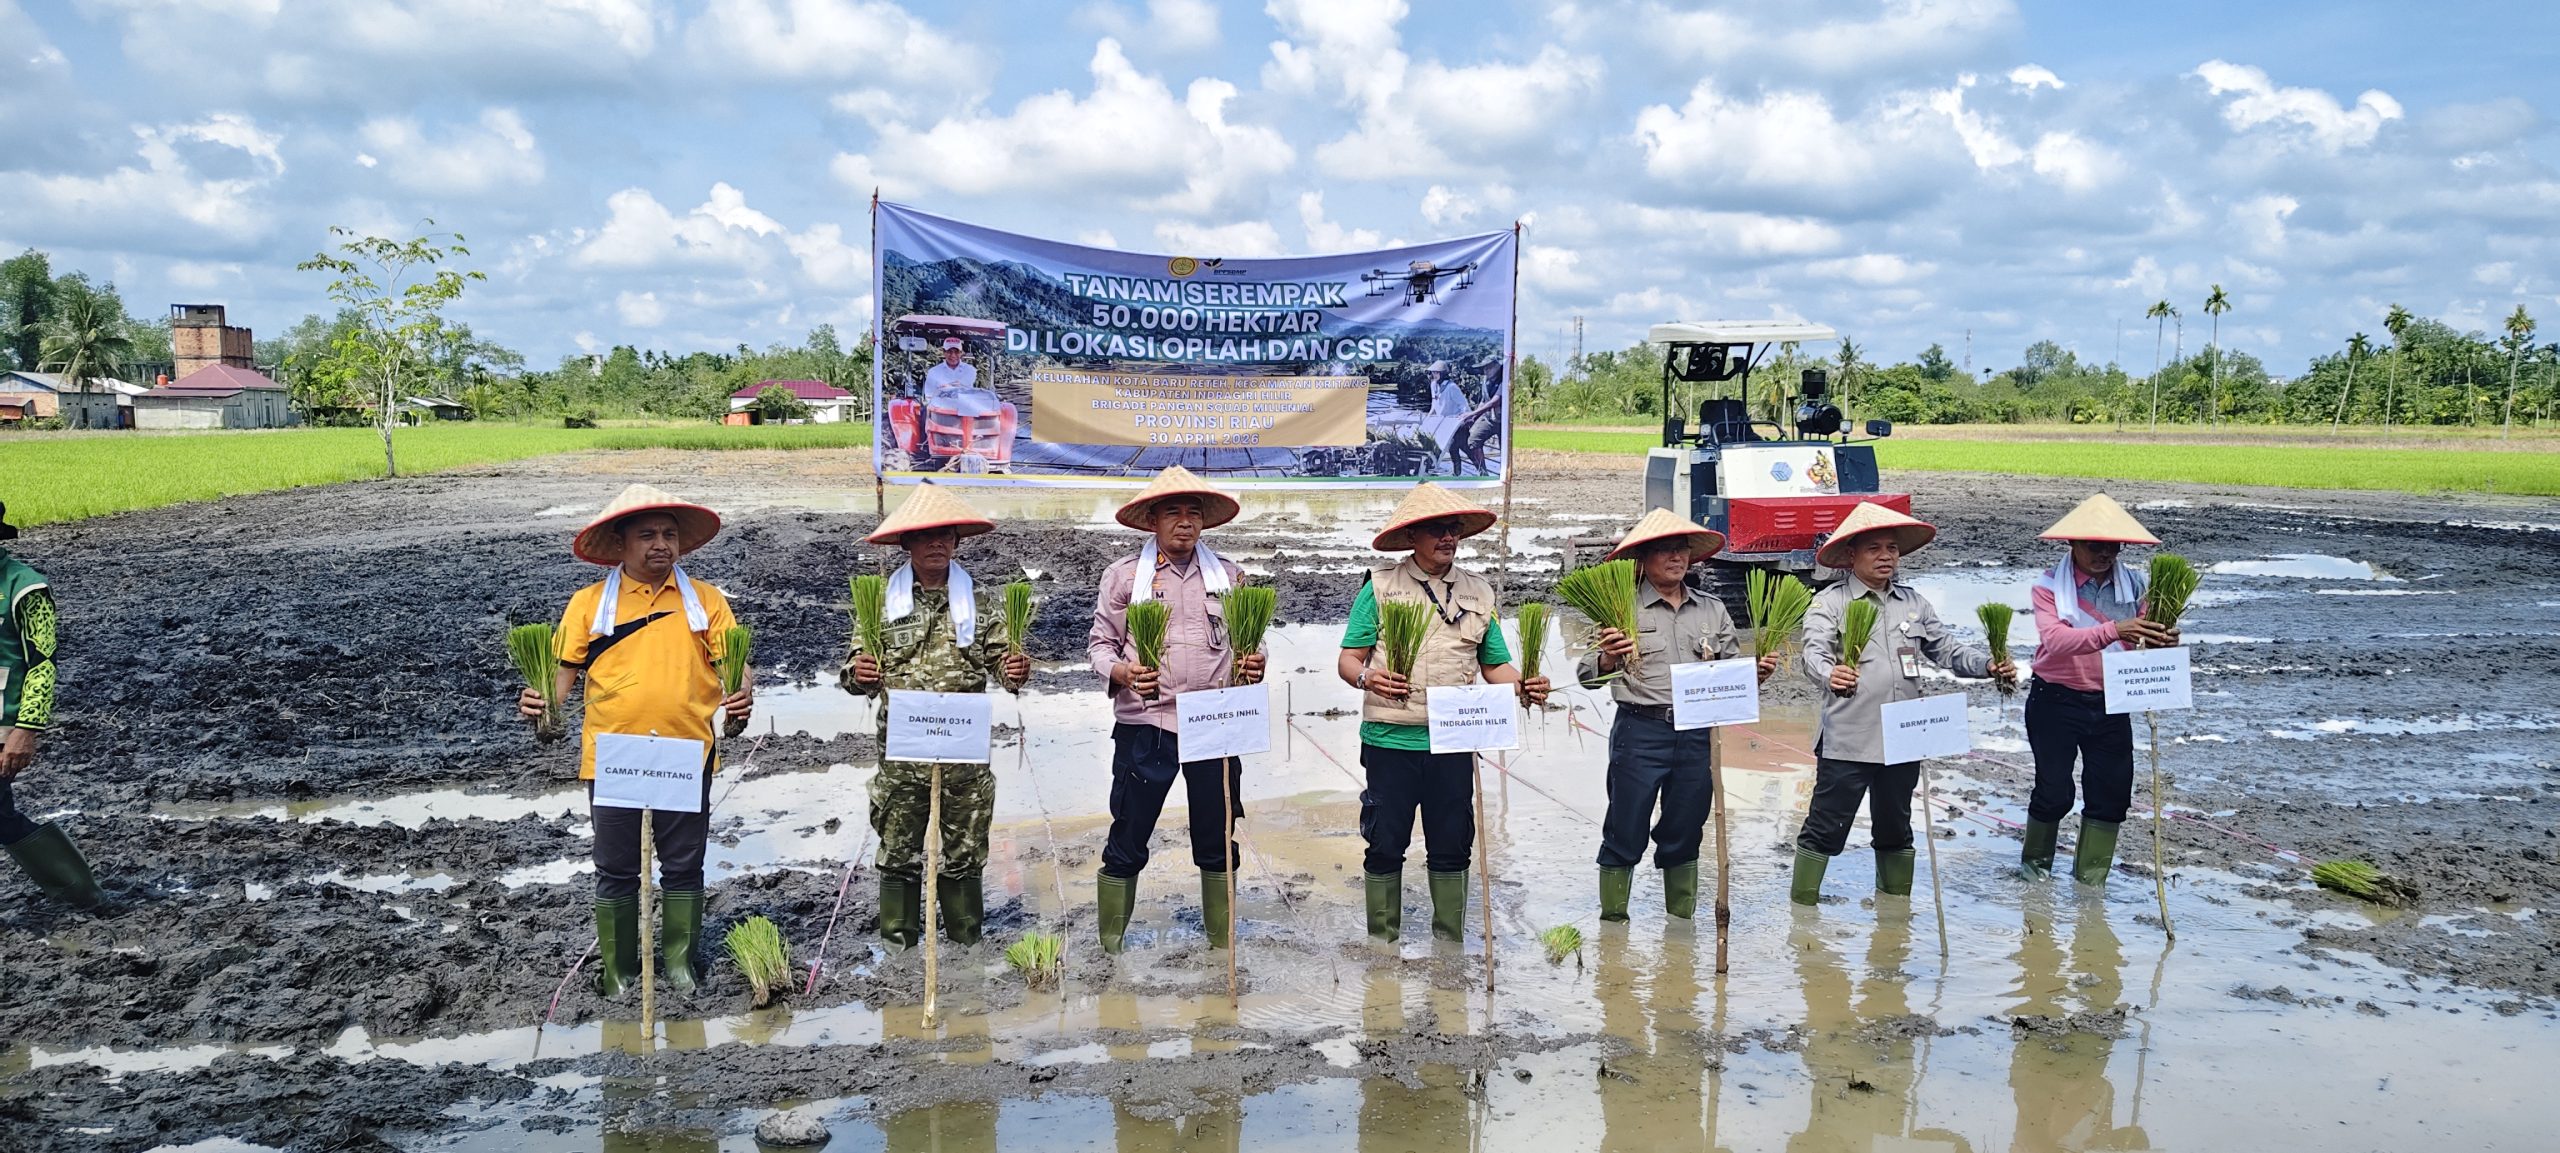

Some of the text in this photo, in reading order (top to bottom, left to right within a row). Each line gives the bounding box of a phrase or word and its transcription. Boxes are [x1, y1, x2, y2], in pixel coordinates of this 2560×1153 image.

[1065, 274, 1346, 306] TANAM SEREMPAK
[1092, 303, 1320, 333] 50.000 HEKTAR
[1007, 327, 1394, 361] DI LOKASI OPLAH DAN CSR
[1033, 372, 1111, 385] KELURAHAN
[1113, 376, 1149, 387] KOTA
[1152, 378, 1186, 388] BARU
[1234, 379, 1312, 389] KECAMATAN
[1315, 379, 1368, 389] KRITANG
[1114, 388, 1292, 401] KABUPATEN INDRAGIRI HILIR
[1091, 399, 1315, 414] BRIGADE PANGAN SQUAD MILLENIAL
[1134, 414, 1275, 430] PROVINSI RIAU
[1149, 432, 1260, 445] 30 APRIL 2026
[2117, 664, 2176, 675] KEPALA DINAS
[2124, 675, 2171, 685] PERTANIAN
[1708, 684, 1747, 694] LEMBANG
[2126, 687, 2171, 697] KAB. INHIL
[1188, 708, 1260, 723] KAPOLRES INHIL
[1458, 707, 1488, 715] BUPATI
[908, 715, 946, 725] DANDIM
[1440, 718, 1508, 728] INDRAGIRI HILIR
[1930, 715, 1950, 725] RIAU
[926, 728, 953, 737] INHIL
[604, 766, 693, 781] CAMAT KERITANG
